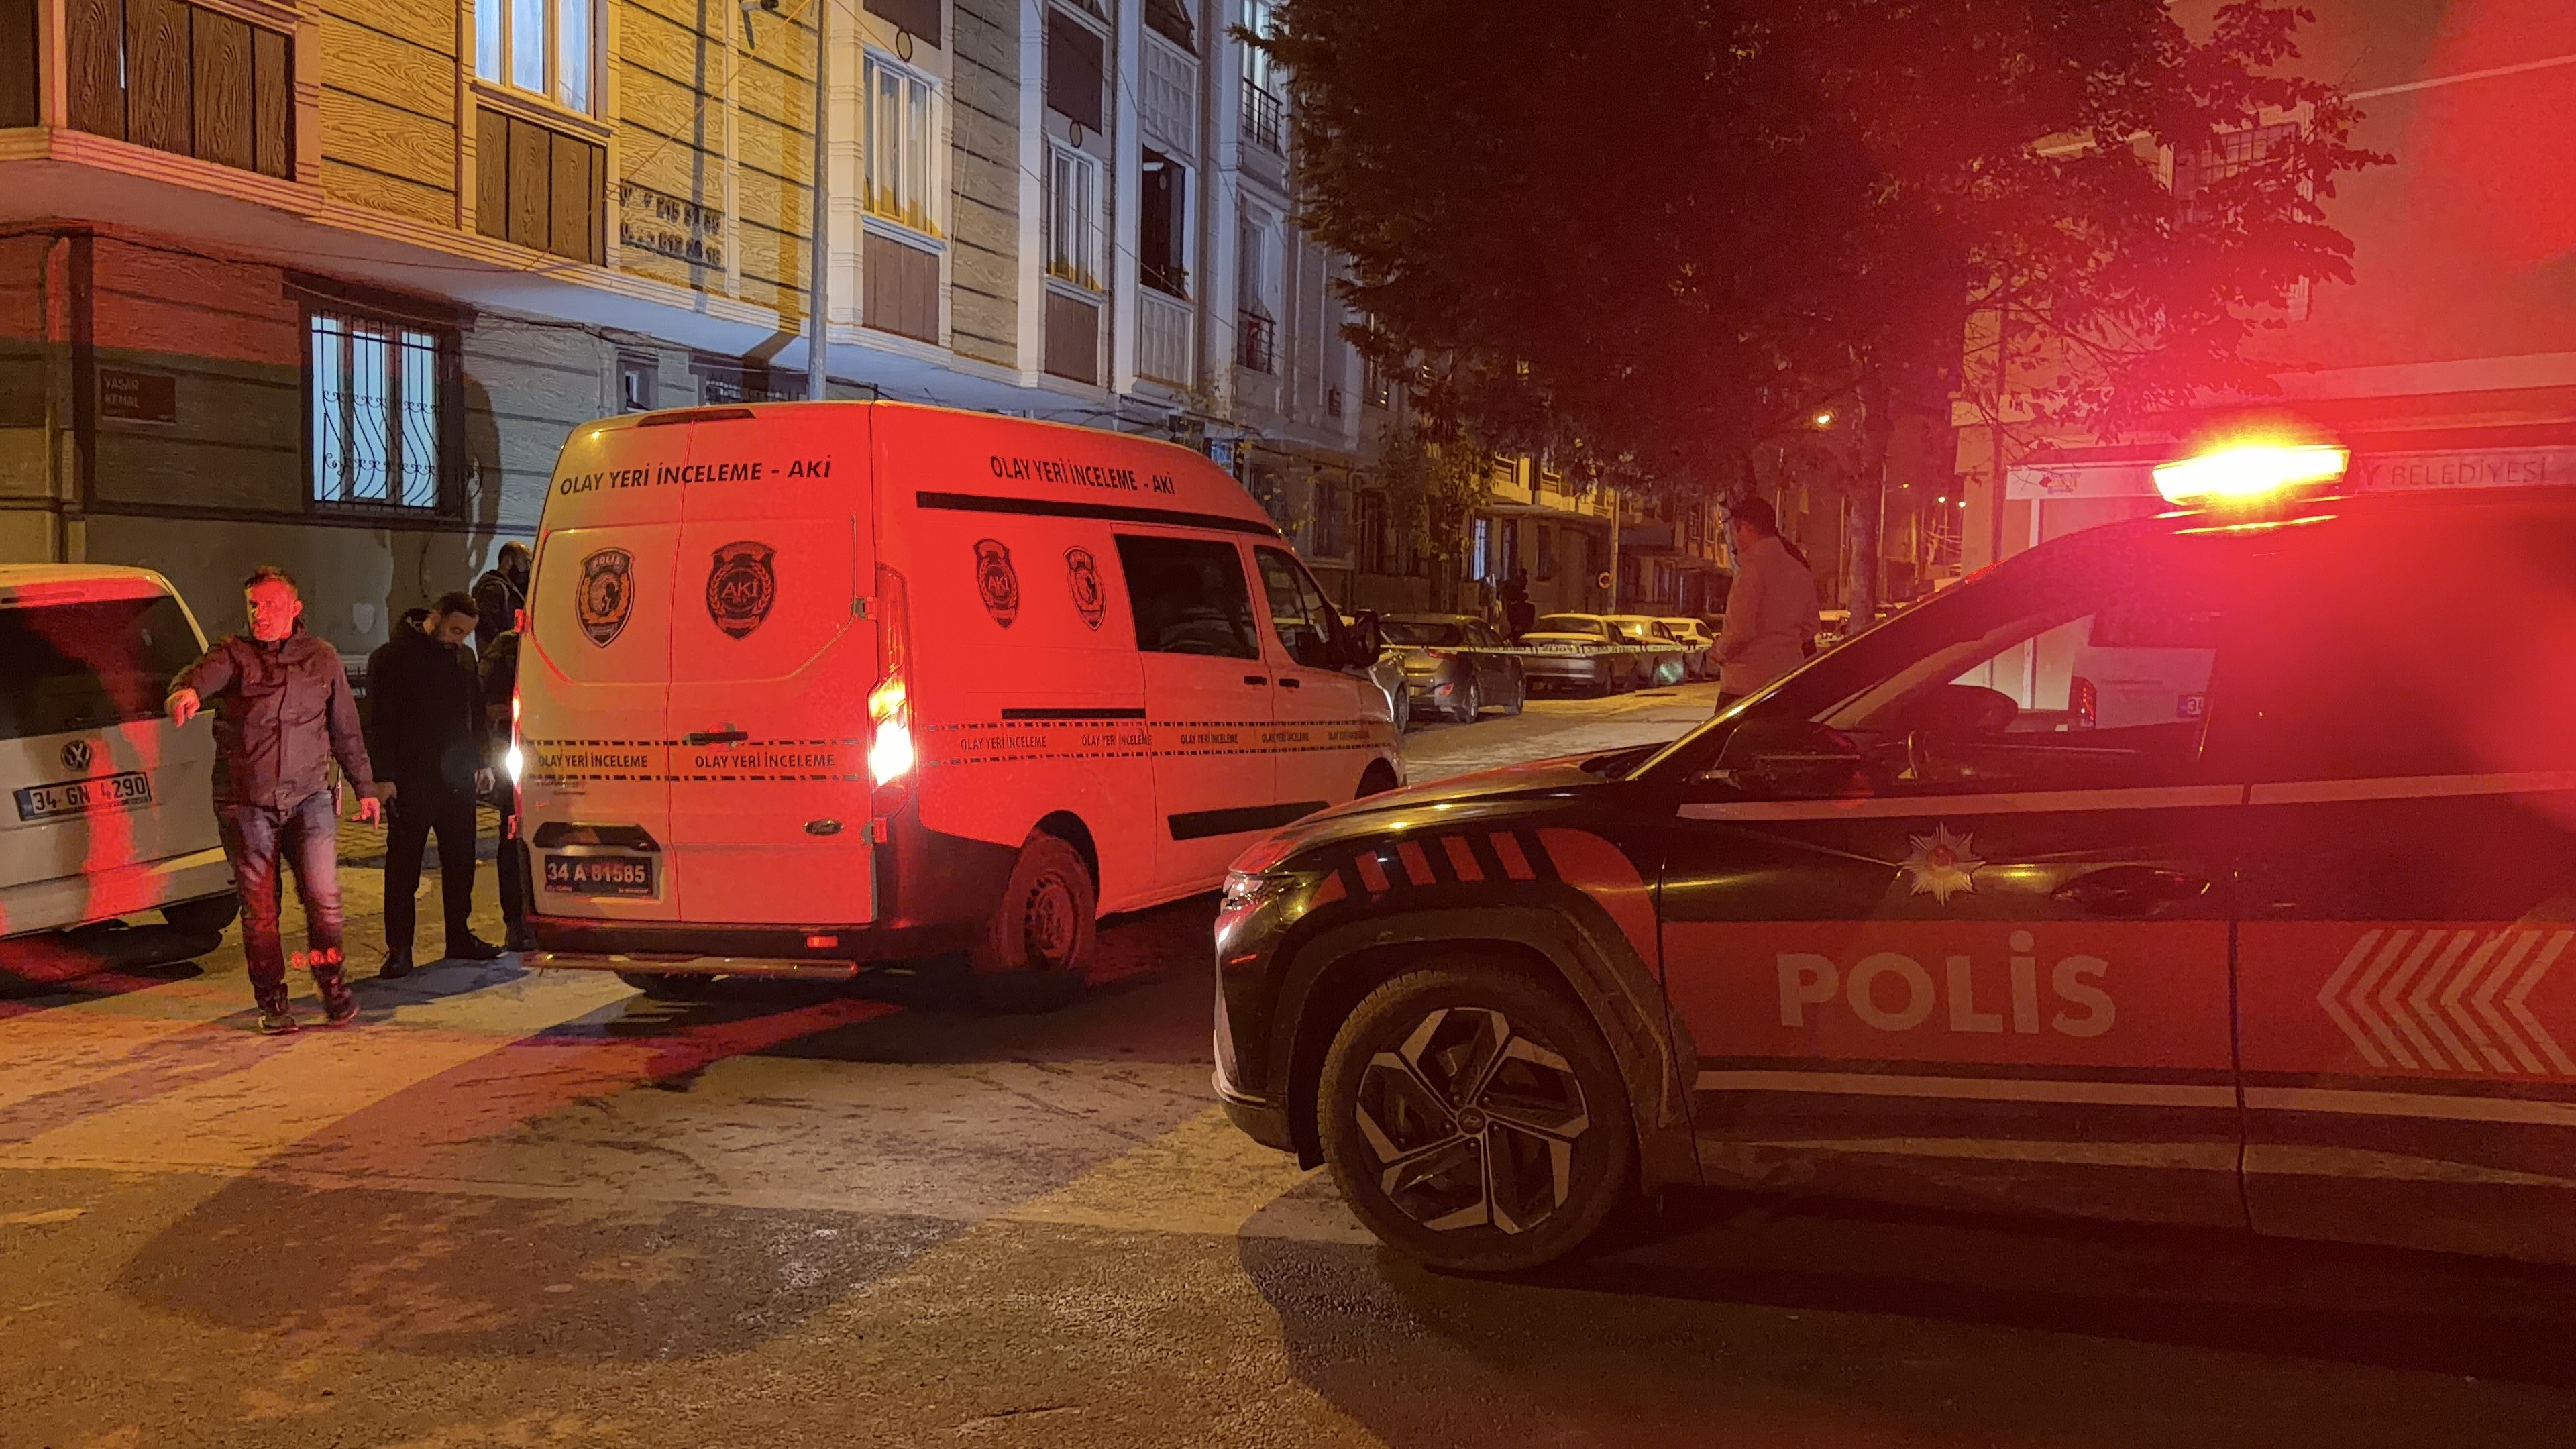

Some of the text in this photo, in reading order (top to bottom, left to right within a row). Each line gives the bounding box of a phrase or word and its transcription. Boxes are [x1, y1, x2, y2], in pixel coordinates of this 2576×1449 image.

[561, 473, 604, 495] OLAY
[609, 463, 649, 488] YERİ
[656, 462, 762, 485] İNCELEME
[788, 455, 830, 477] AKİ
[991, 455, 1030, 480] OLAY
[1033, 458, 1068, 483] YERİ
[1069, 459, 1137, 490] İNCELEME
[1152, 471, 1175, 494] AKİ
[2392, 457, 2546, 486] BELEDİYESİ
[720, 578, 759, 597] AKİ
[961, 734, 1046, 751] OLAY YERİ İNCELEME
[1081, 735, 1100, 747] OLAY
[539, 752, 647, 767] OLAY YERİ İNCELEME
[695, 751, 835, 767] OLAY YERİ İNCELEME
[33, 791, 56, 810] 34
[101, 776, 146, 800] 4290
[547, 863, 569, 881] 34
[574, 863, 586, 881] A
[1776, 930, 2116, 1037] POLİS
